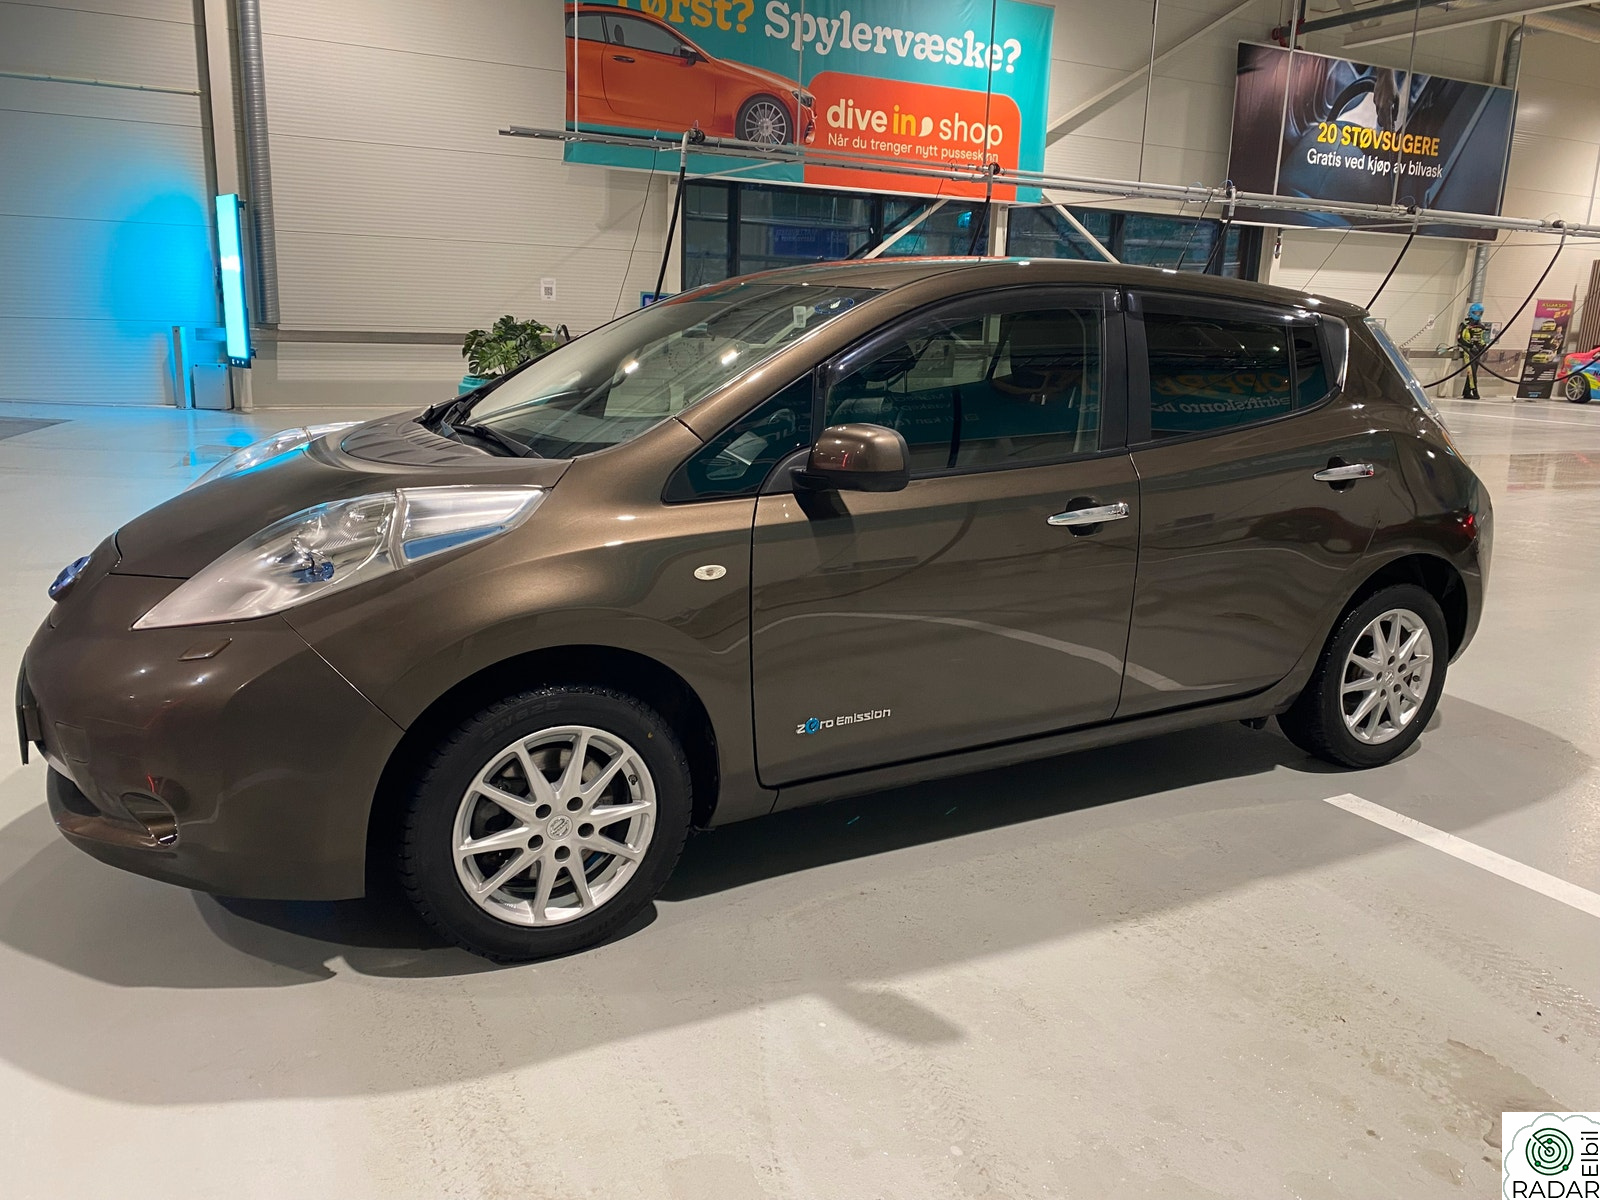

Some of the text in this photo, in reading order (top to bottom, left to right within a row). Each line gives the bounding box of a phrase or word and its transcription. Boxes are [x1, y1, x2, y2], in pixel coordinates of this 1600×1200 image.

[765, 0, 1022, 74] Spylervæske?
[827, 99, 1003, 148] dive in shop
[1317, 121, 1441, 157] 20 STØVSUGERE
[828, 133, 999, 163] Når du trenger nytt pussesknn
[1306, 148, 1444, 178] Gratis ved kjøp av bilvask
[836, 708, 891, 726] Emission
